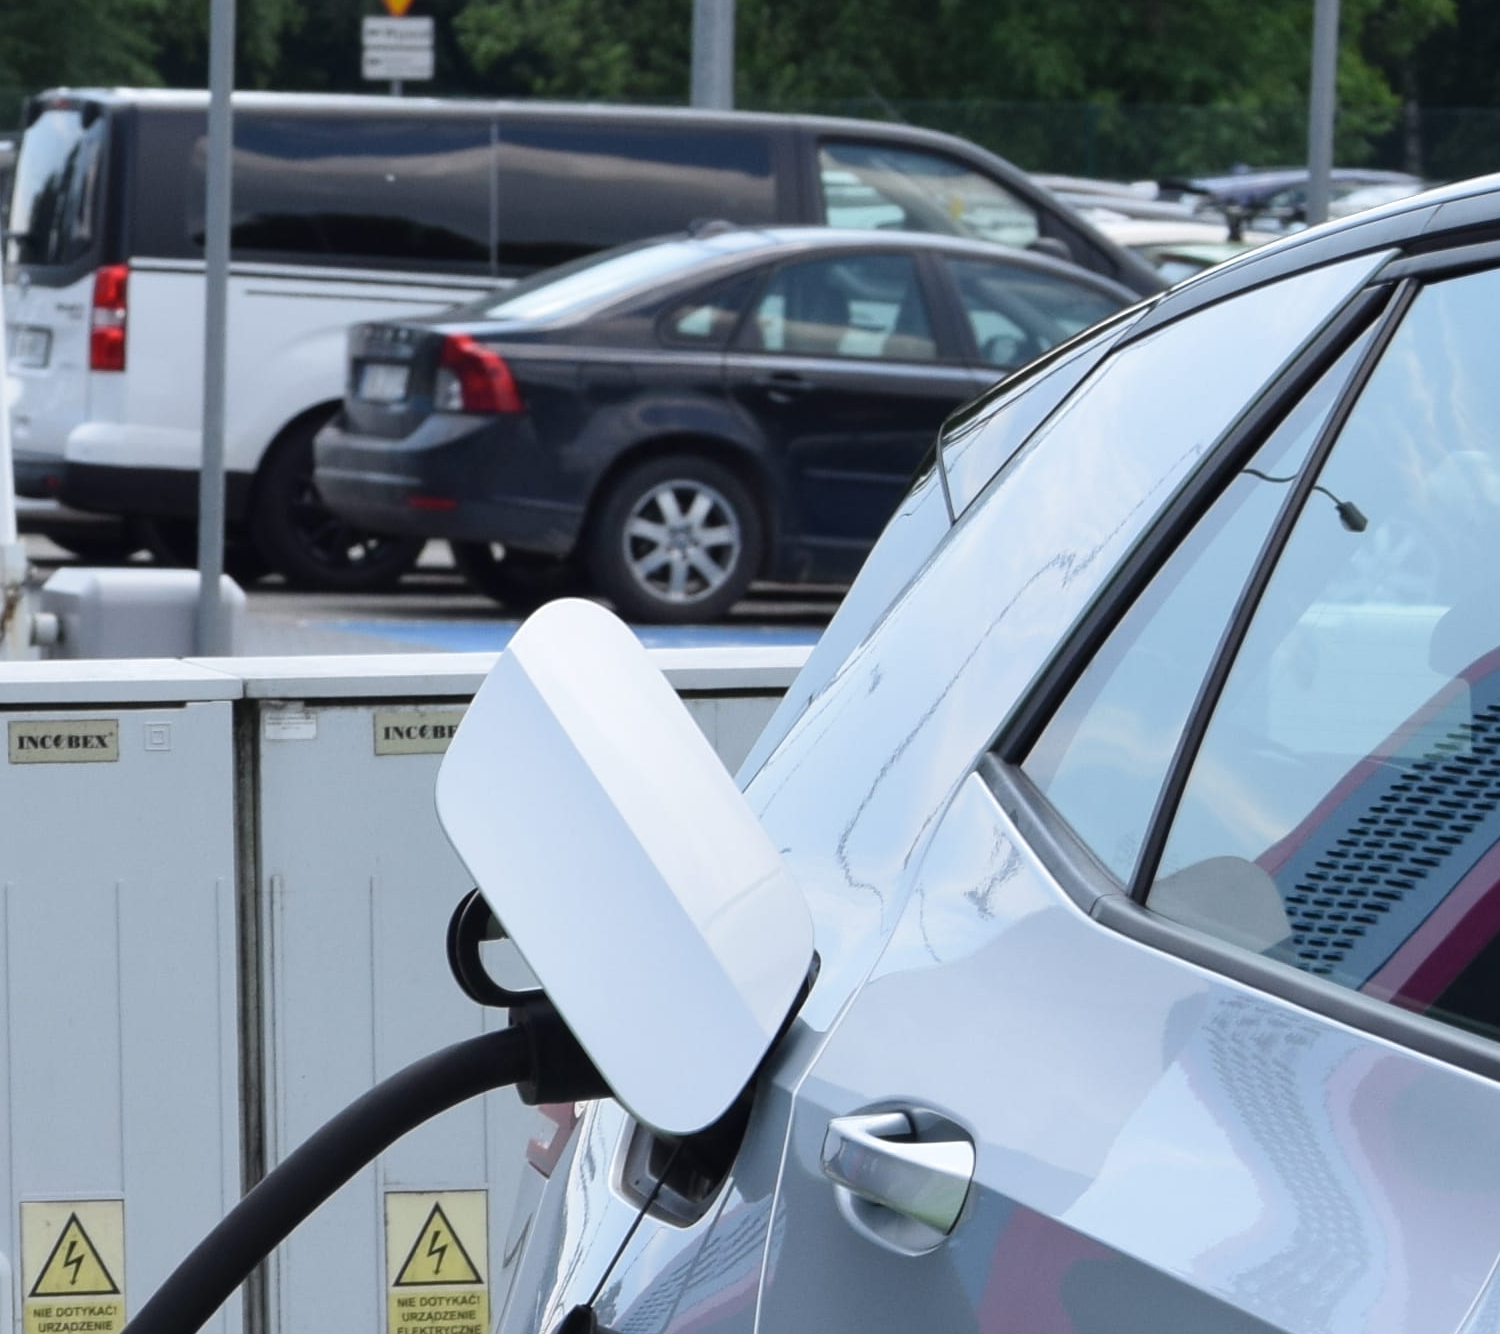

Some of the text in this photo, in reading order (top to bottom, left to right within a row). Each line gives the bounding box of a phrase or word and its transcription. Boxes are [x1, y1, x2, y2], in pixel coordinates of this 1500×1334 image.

[397, 1293, 480, 1308] NIE DOTYKAĆ!
[33, 1305, 117, 1318] NIE DOTYKAĆ!
[402, 1310, 476, 1323] URZĄDZENIE
[38, 1320, 113, 1334] URZĄDZENIE
